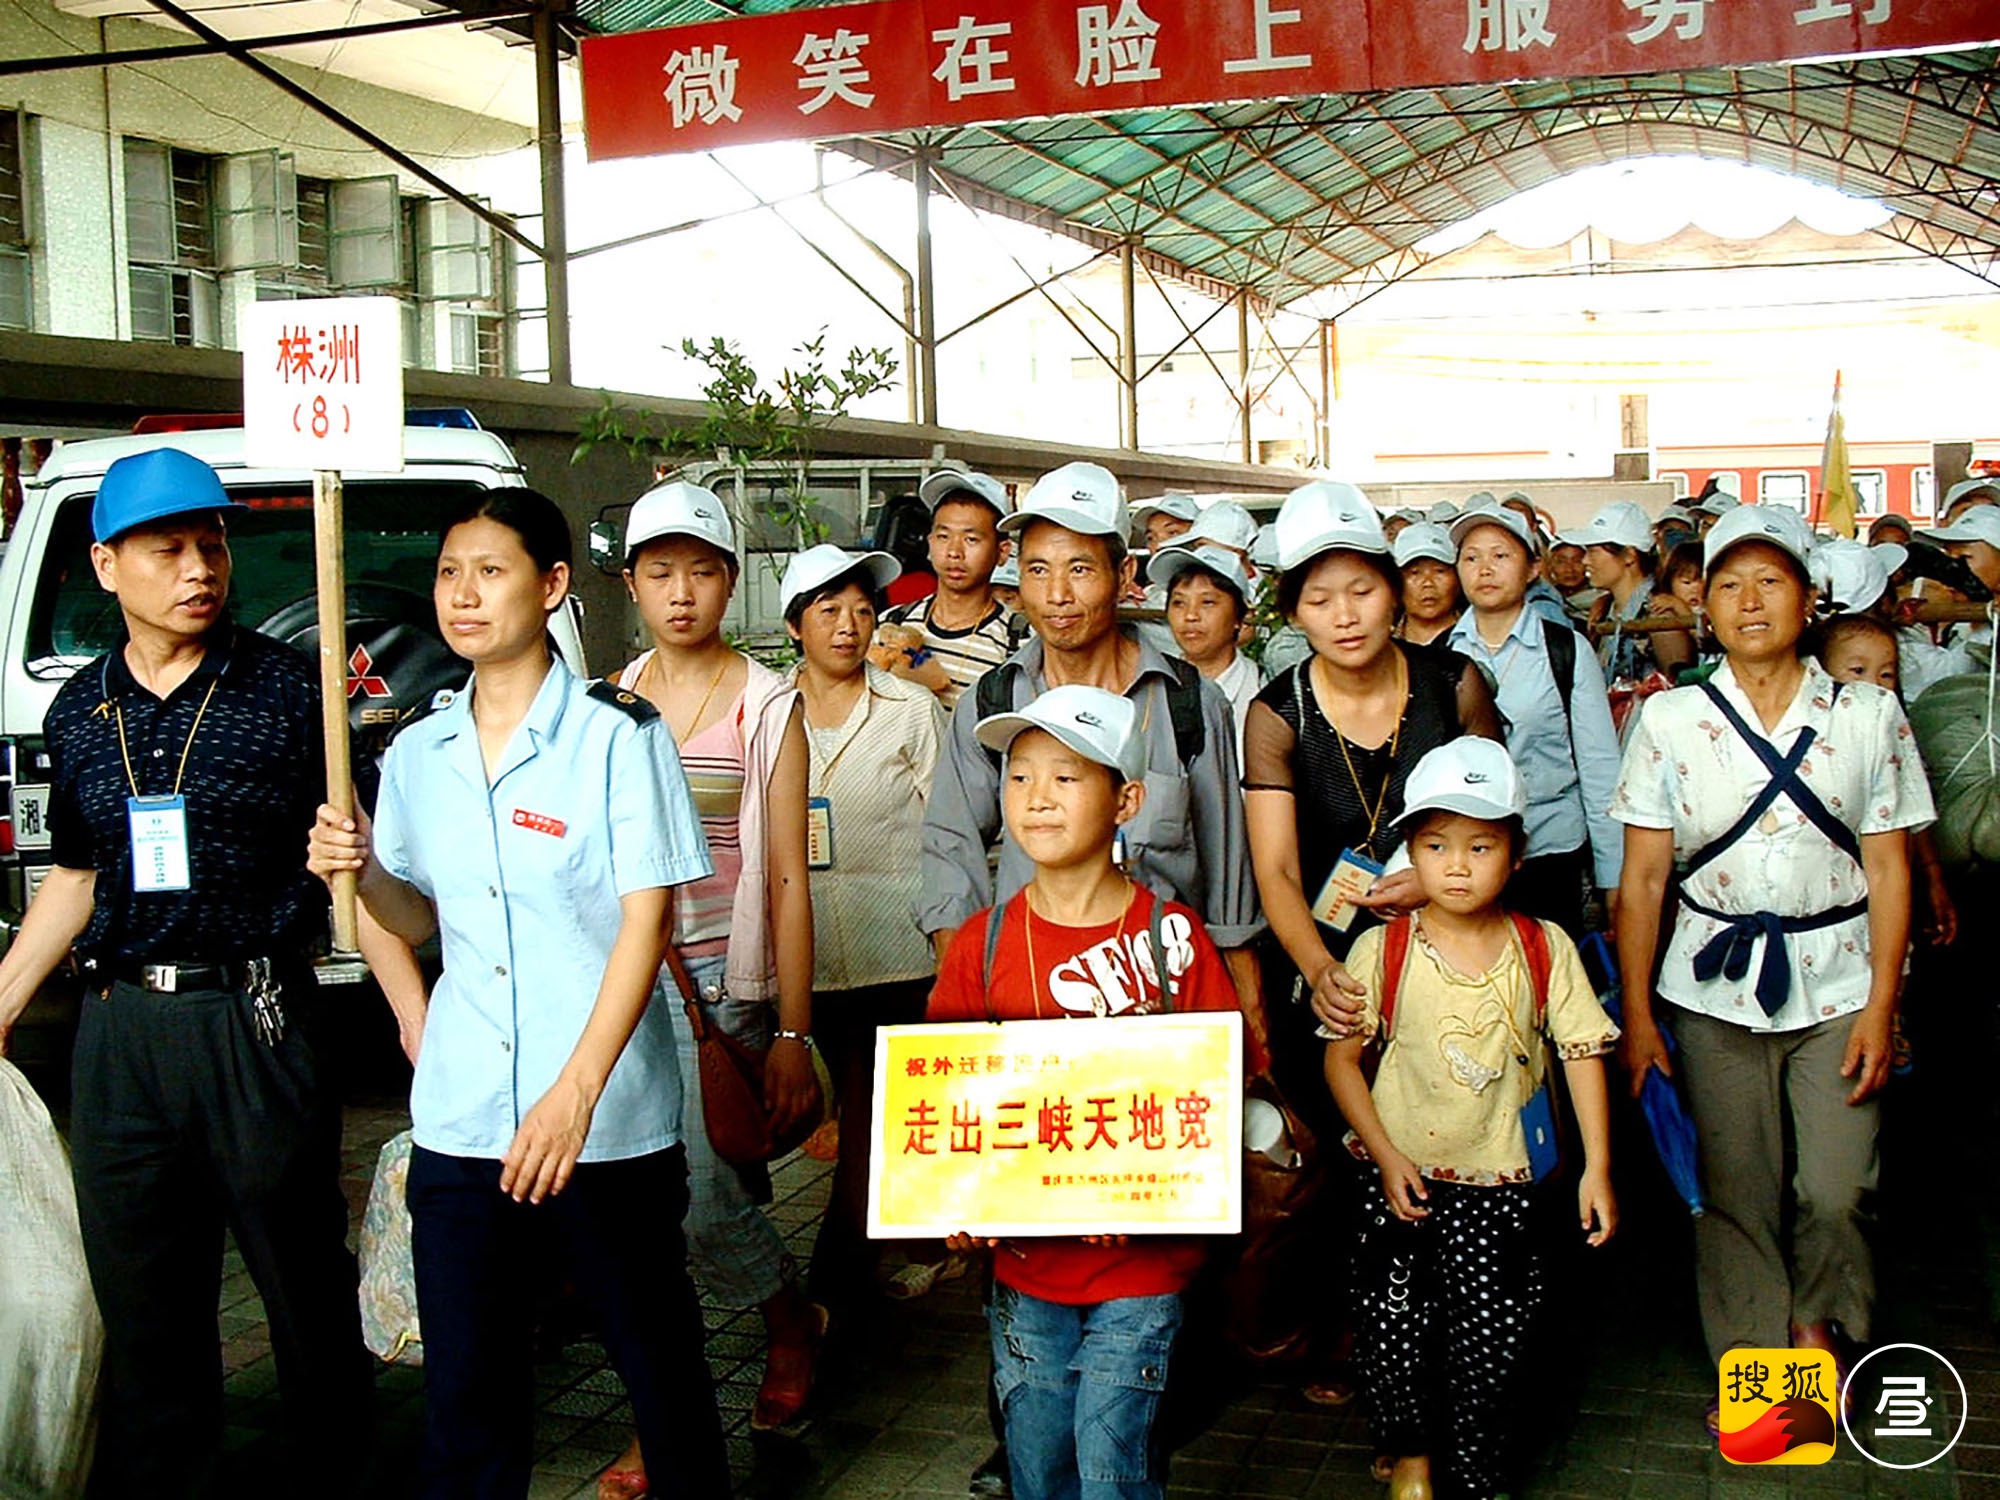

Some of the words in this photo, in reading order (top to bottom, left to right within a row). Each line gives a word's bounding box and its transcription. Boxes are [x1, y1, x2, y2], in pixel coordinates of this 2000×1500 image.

[663, 0, 1312, 128] 微笑在脸上
[276, 324, 360, 385] 株洲
[903, 1090, 1212, 1155] 走出三峡天地宽
